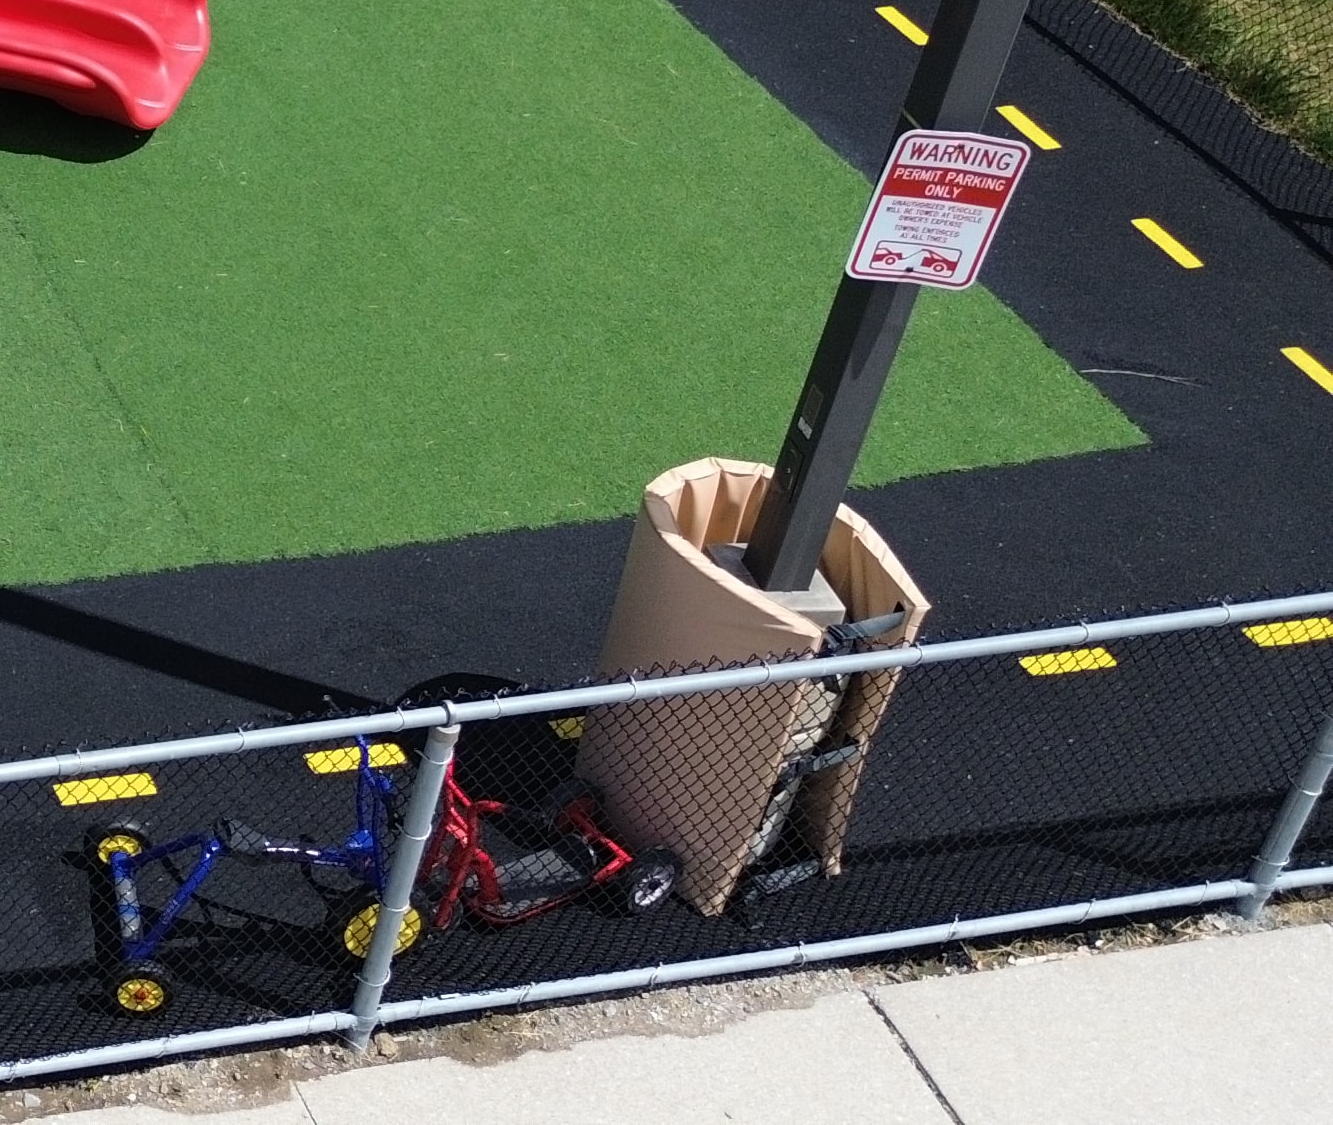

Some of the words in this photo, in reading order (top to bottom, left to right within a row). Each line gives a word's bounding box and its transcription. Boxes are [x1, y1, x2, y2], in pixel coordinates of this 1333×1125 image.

[908, 142, 1014, 171] WARNING
[893, 167, 943, 182] PERMIT
[944, 171, 1007, 191] PARKING
[924, 184, 963, 198] ONLY
[891, 200, 945, 210] UNAUTHORIZED
[948, 205, 983, 216] VEHICLES
[930, 218, 964, 228] EXPENSE
[953, 214, 983, 224] VEHICLE
[922, 227, 960, 237] ENFORCED
[926, 235, 948, 243] TIMES
